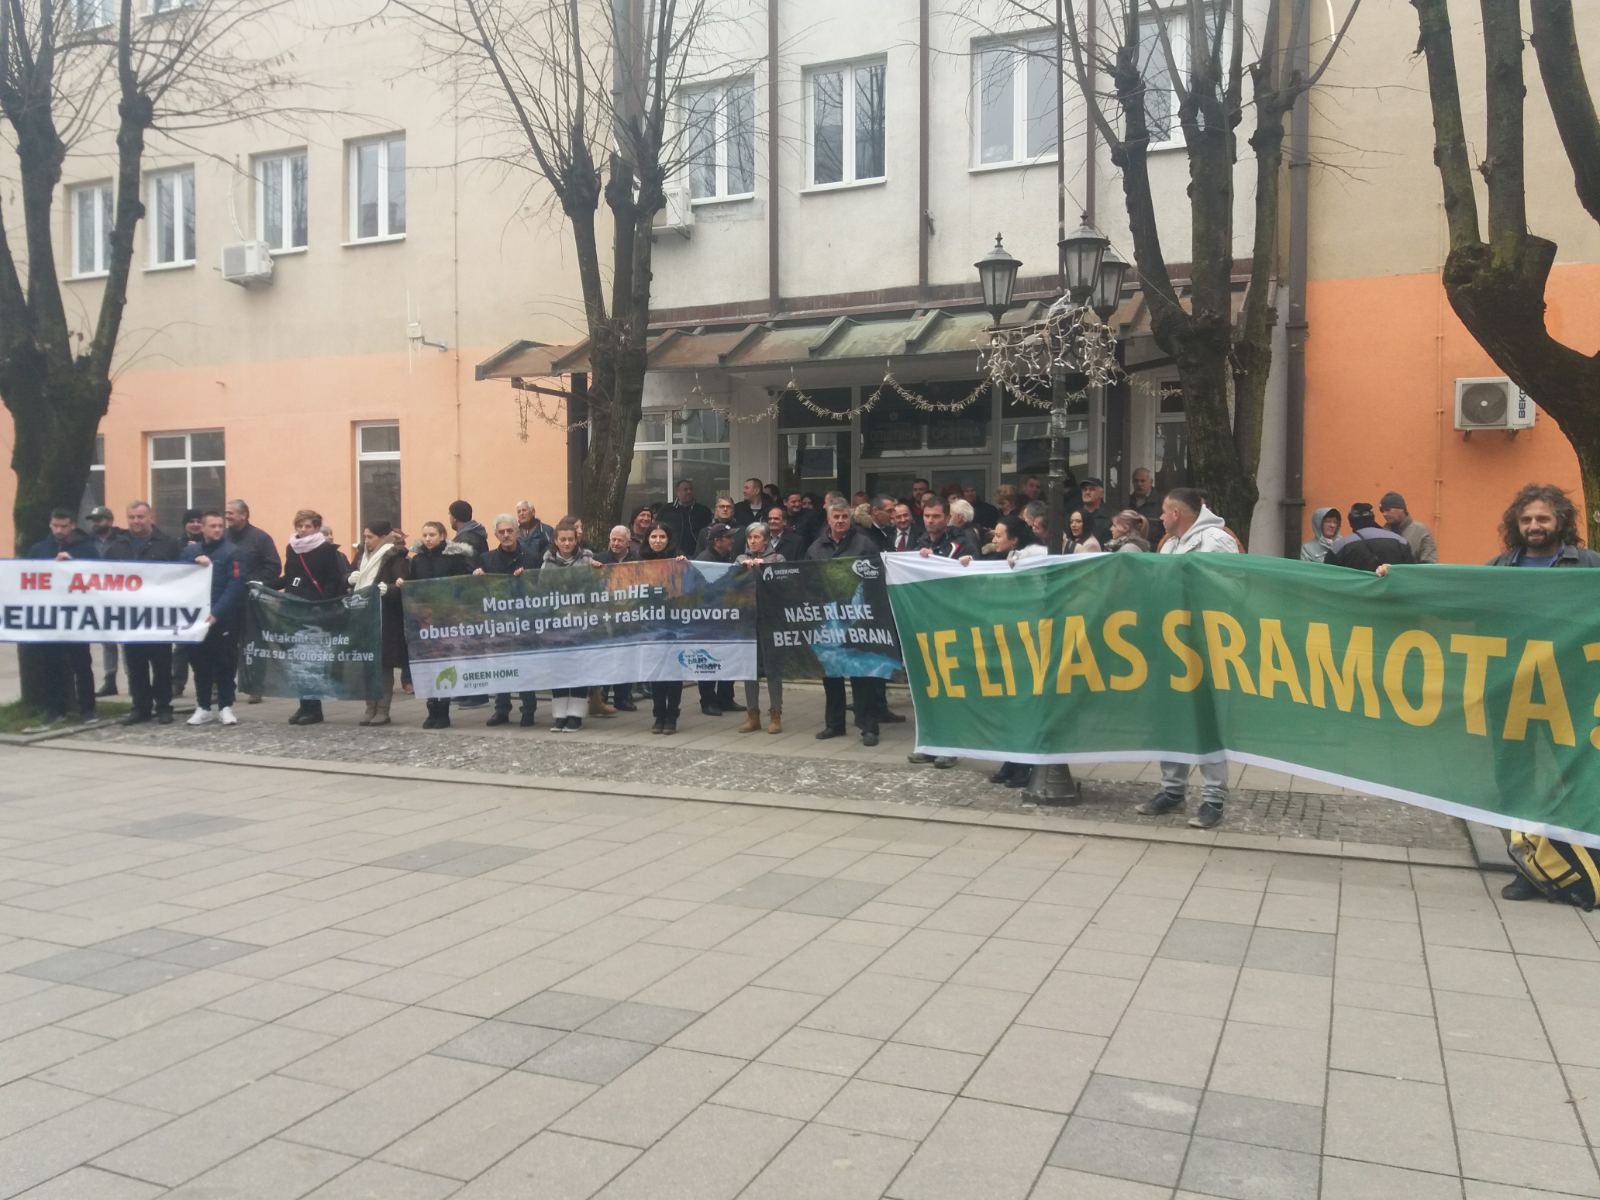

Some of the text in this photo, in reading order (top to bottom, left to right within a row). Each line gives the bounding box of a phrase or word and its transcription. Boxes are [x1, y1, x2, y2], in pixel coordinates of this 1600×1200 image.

[20, 572, 143, 593] НЕ ДАМО
[483, 583, 663, 612] Moratorijum na mHE =
[0, 605, 202, 635] ЕШТАНИЦУ
[419, 605, 740, 640] obustavljanje gradnje + raskid ugovora
[784, 601, 874, 623] NAŠE RIJEKE
[773, 624, 894, 647] BEZ VAŠIH BRANA
[272, 650, 286, 659] su
[337, 650, 374, 661] države
[916, 629, 966, 698] JE
[970, 623, 1016, 696] LI
[1017, 609, 1148, 696] VAS
[462, 669, 519, 681] GREEN HOME
